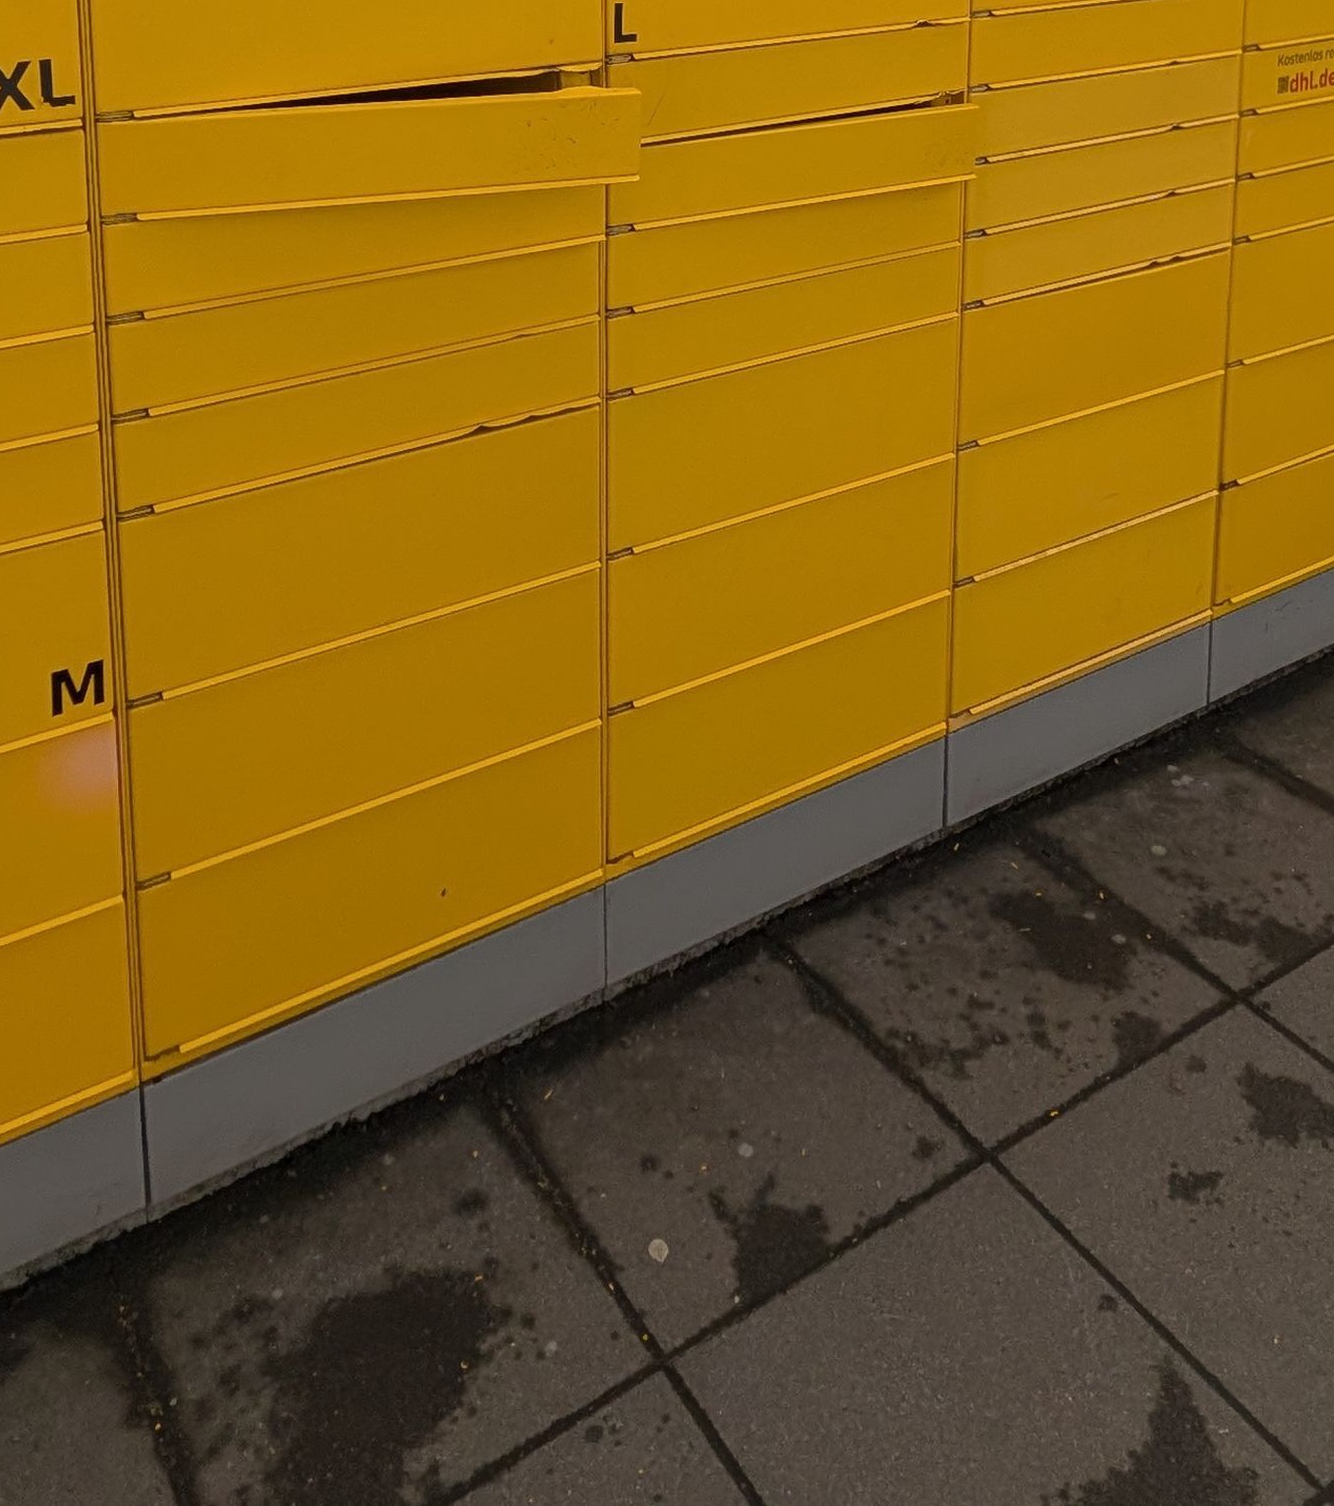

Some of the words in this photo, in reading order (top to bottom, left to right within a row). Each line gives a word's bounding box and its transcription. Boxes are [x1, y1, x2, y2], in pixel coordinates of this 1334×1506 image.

[613, 2, 638, 44] L
[1277, 49, 1323, 67] Kostenlos
[50, 659, 105, 717] M
